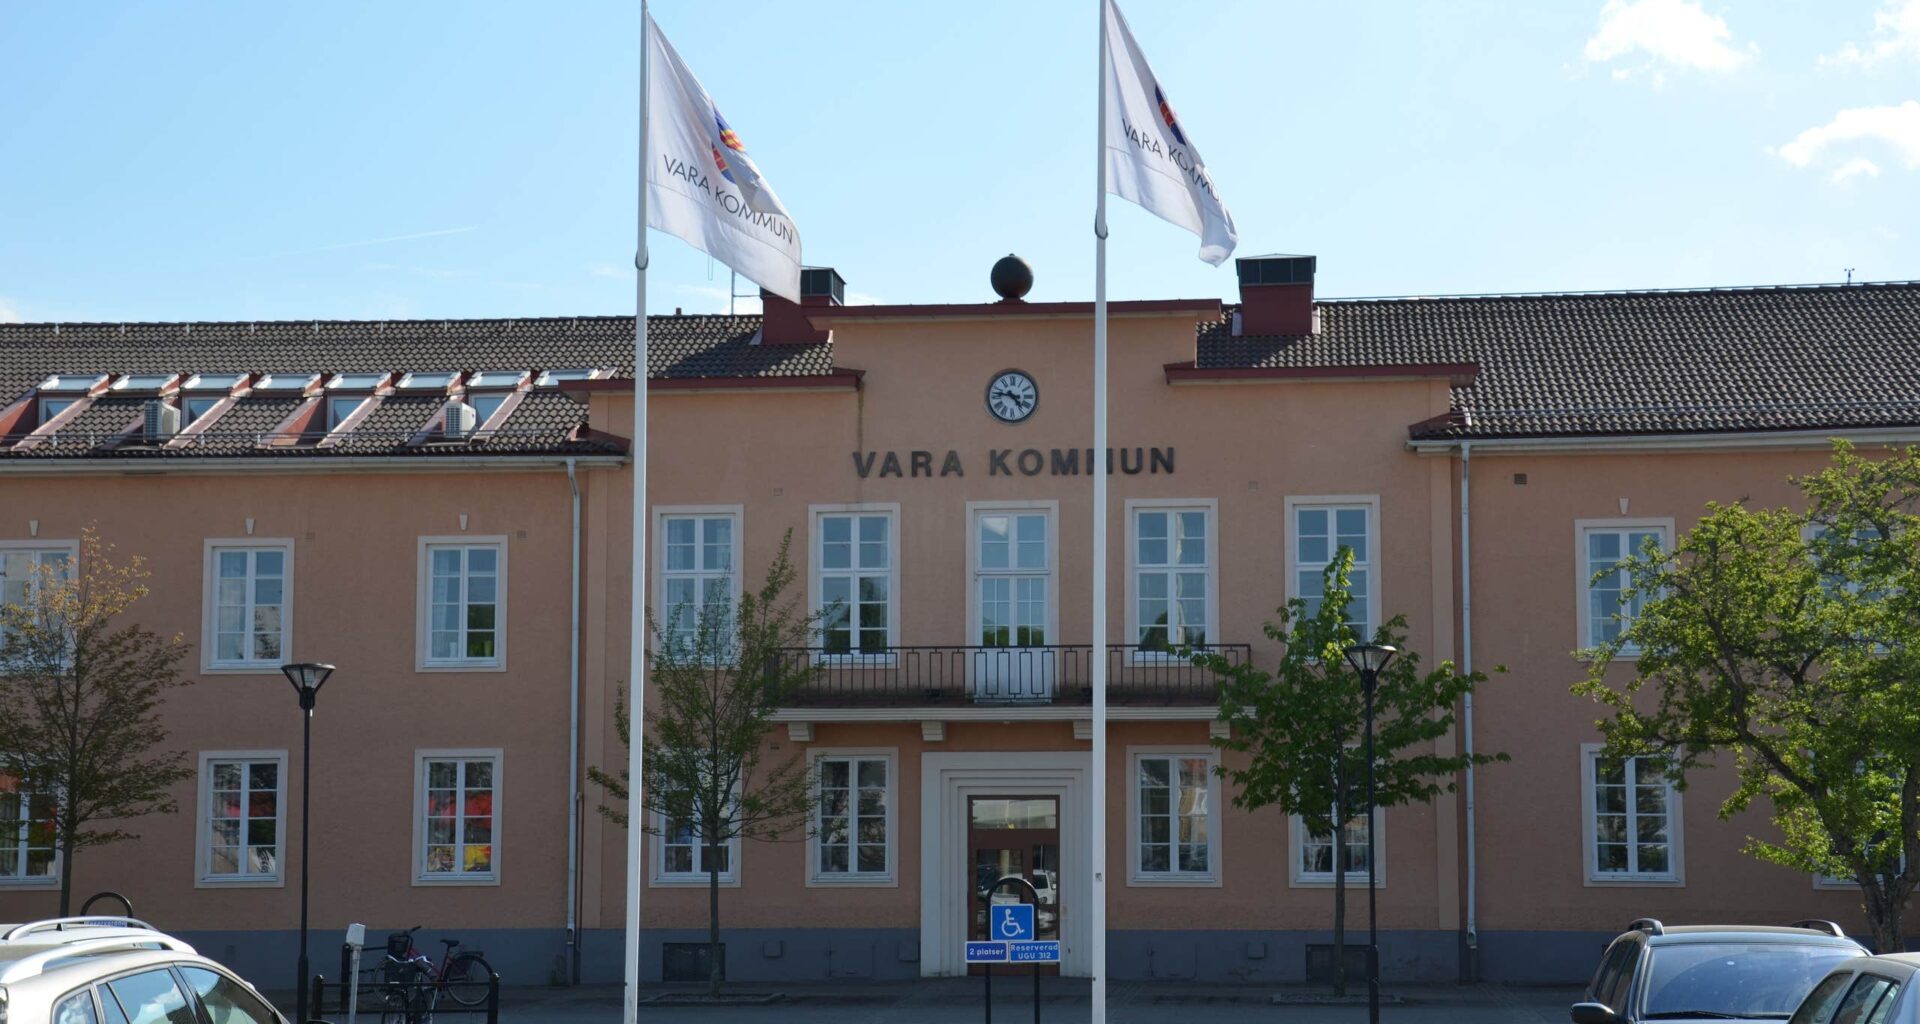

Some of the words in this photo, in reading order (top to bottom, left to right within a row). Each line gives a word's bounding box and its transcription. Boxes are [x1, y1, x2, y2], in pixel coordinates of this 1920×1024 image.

[1121, 118, 1163, 160] VARA
[663, 154, 711, 196] VARA
[715, 186, 793, 246] KOMMUN
[852, 450, 964, 478] VARA
[969, 948, 975, 956] 2
[976, 948, 1004, 956] platser
[1018, 952, 1035, 960] UGU
